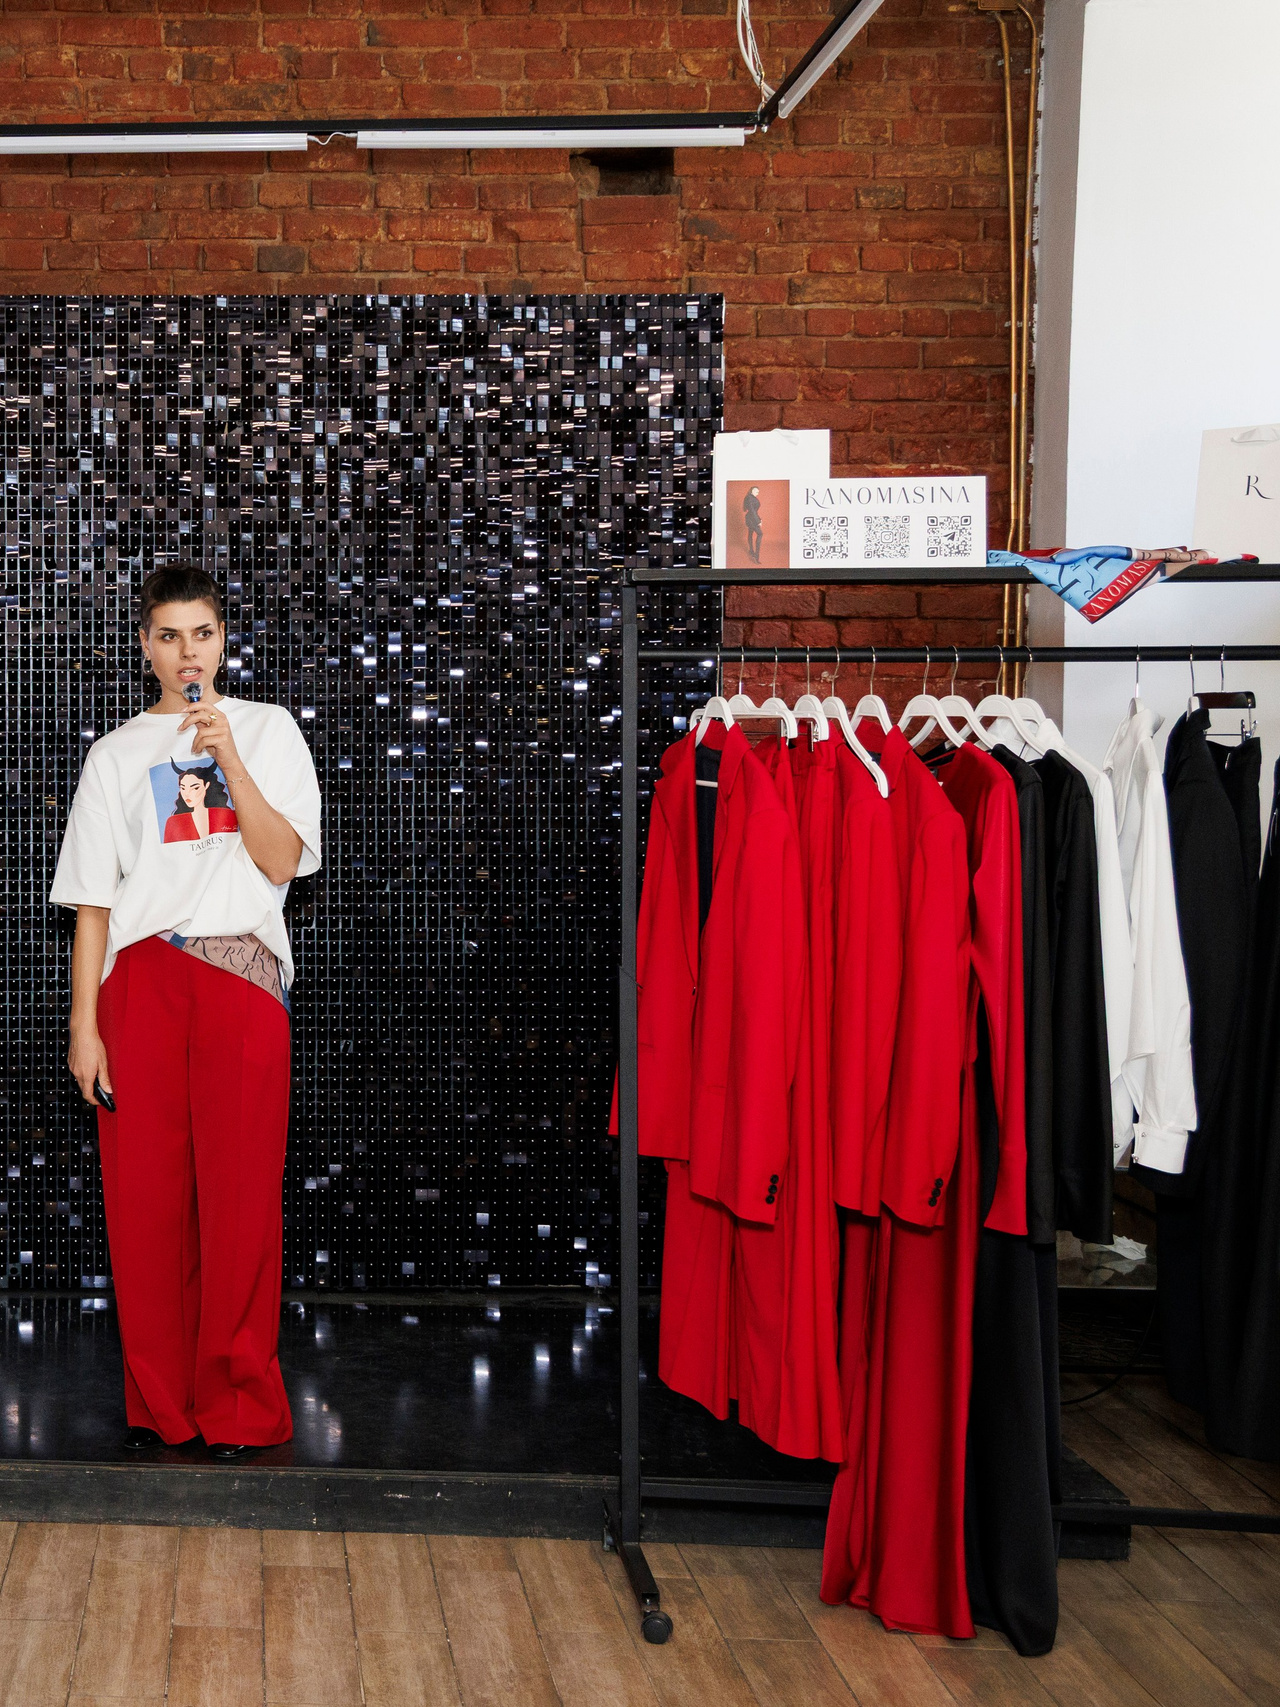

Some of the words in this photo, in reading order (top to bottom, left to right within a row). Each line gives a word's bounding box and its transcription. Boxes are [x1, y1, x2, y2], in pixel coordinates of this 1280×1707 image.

[805, 486, 970, 509] RANOMASINA
[1245, 475, 1274, 500] R
[190, 836, 223, 852] TAURUS
